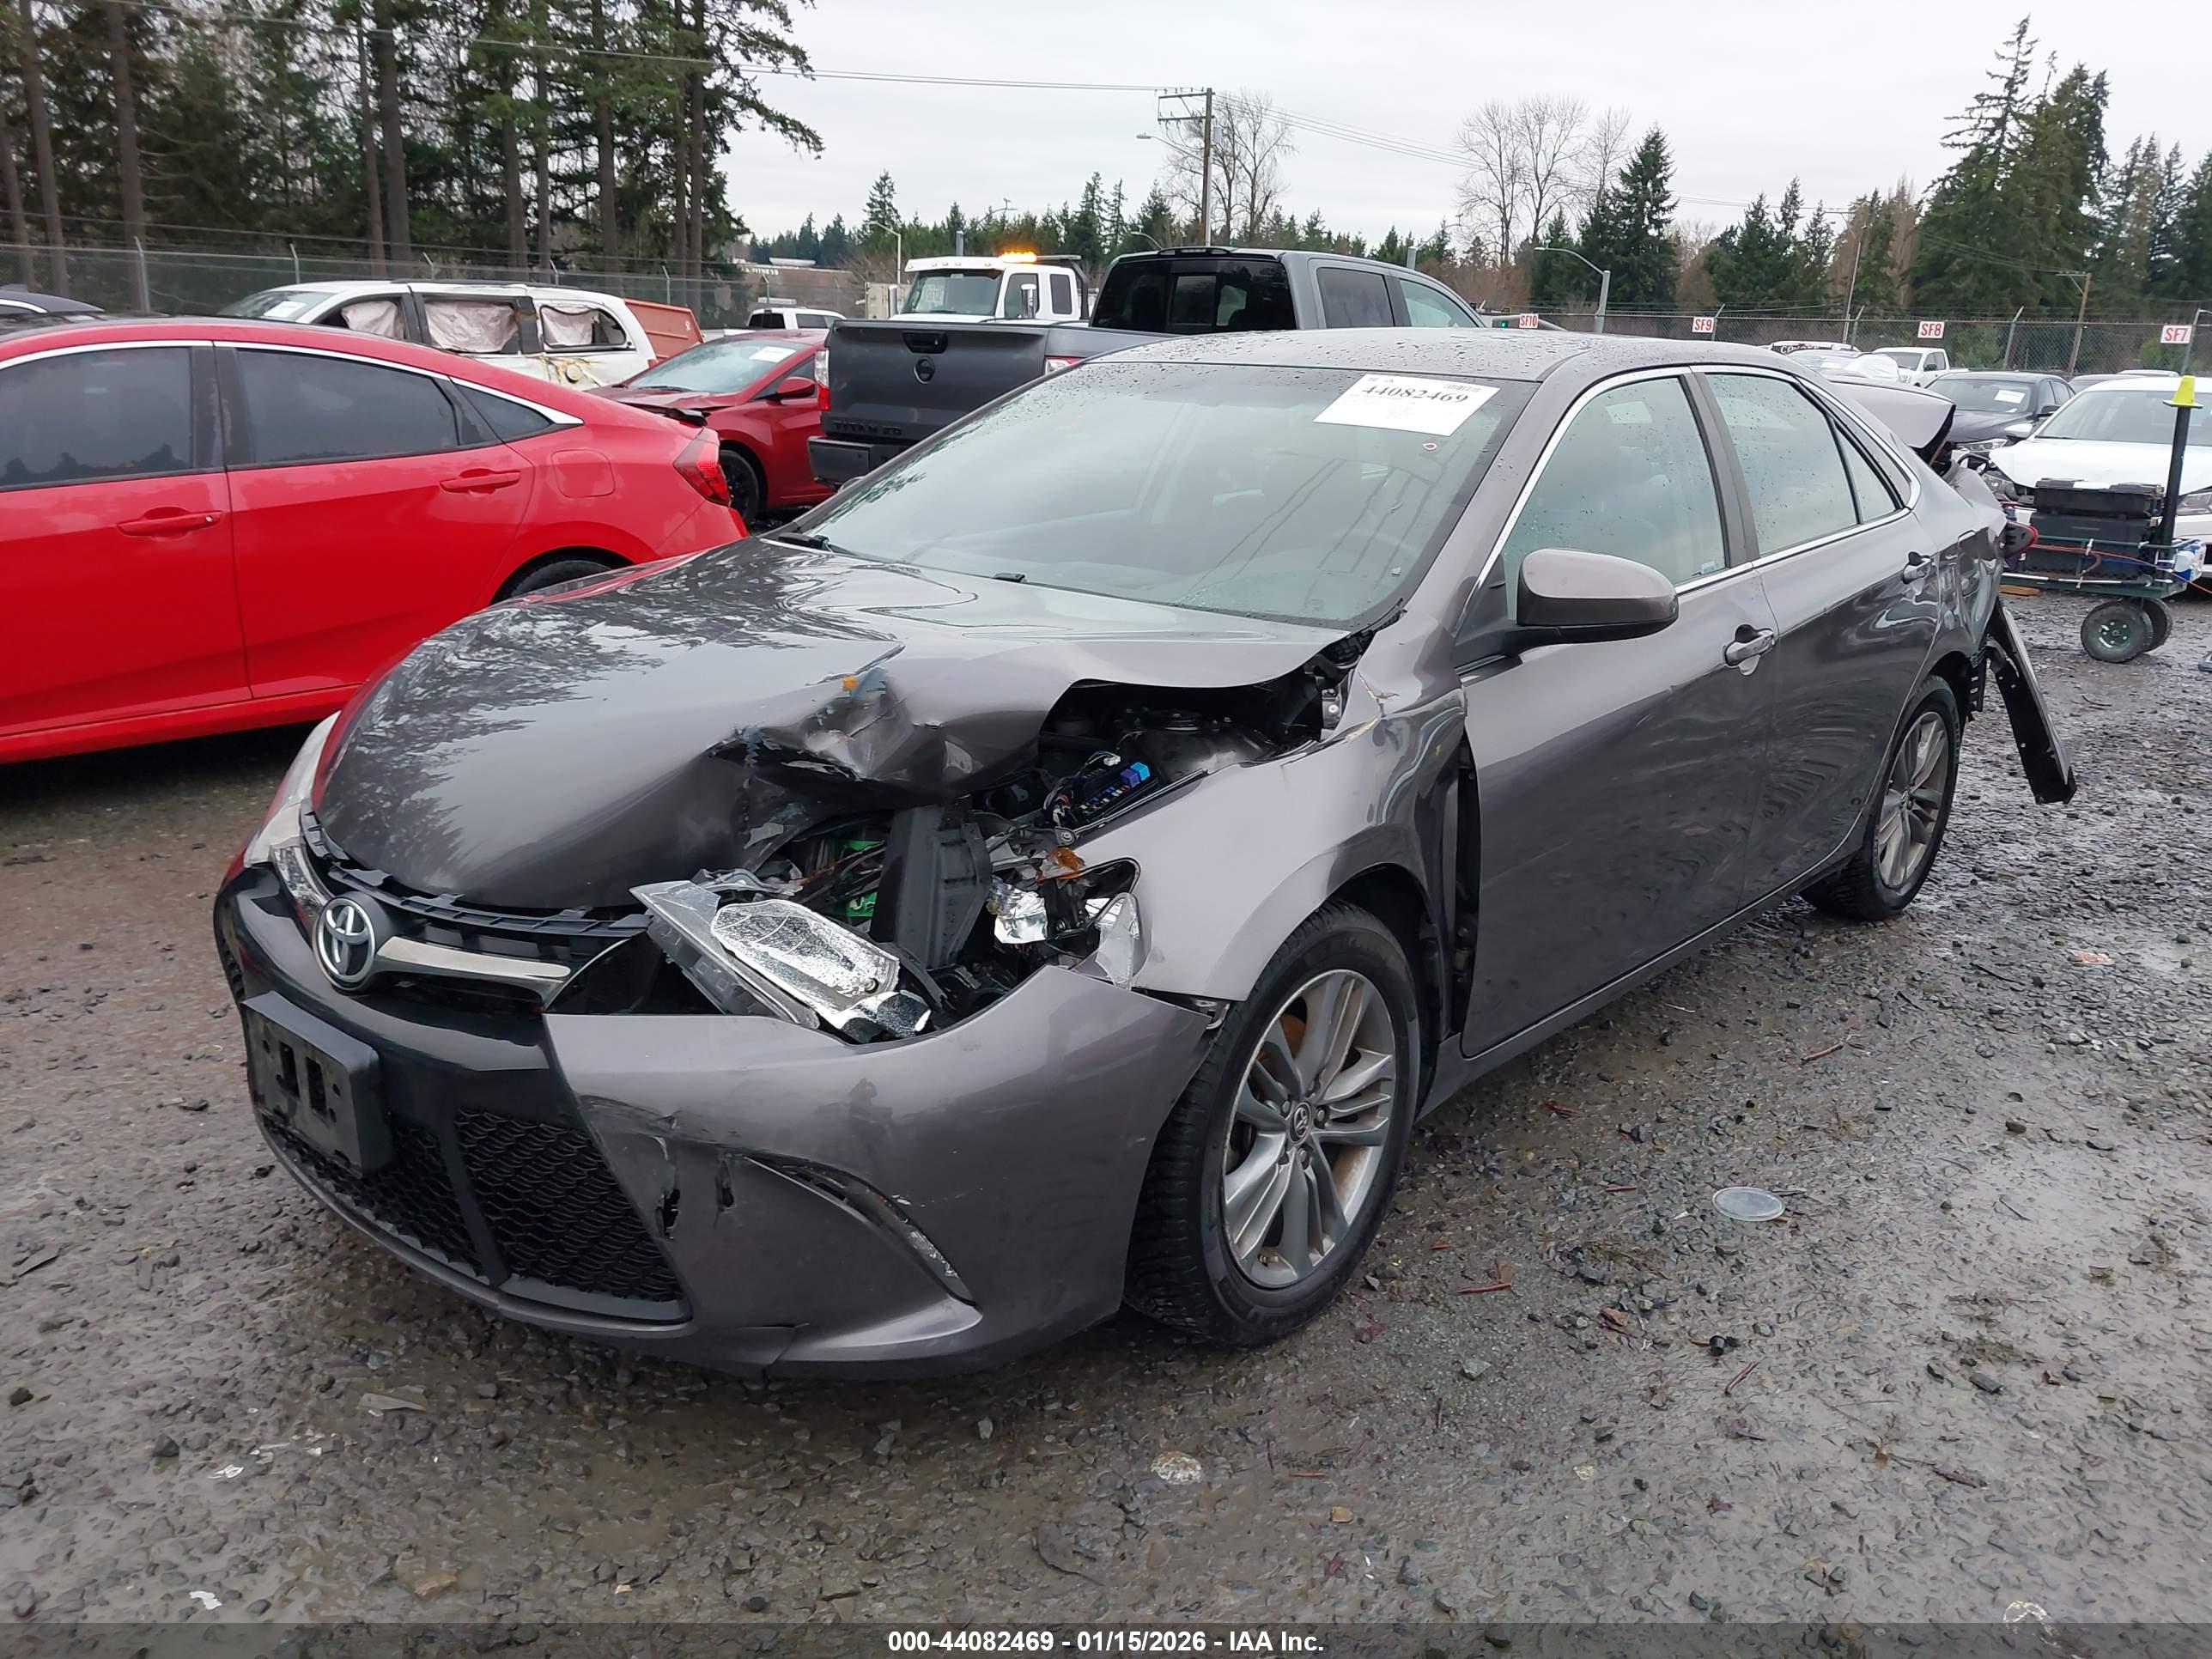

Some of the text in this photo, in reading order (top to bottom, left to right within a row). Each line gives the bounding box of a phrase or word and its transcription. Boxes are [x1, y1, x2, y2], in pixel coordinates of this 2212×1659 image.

[1520, 315, 1538, 326] SF10
[1694, 319, 1712, 331] SF9
[1921, 323, 1942, 336] SF8
[2165, 327, 2188, 341] SF7
[1361, 385, 1469, 404] 44082469
